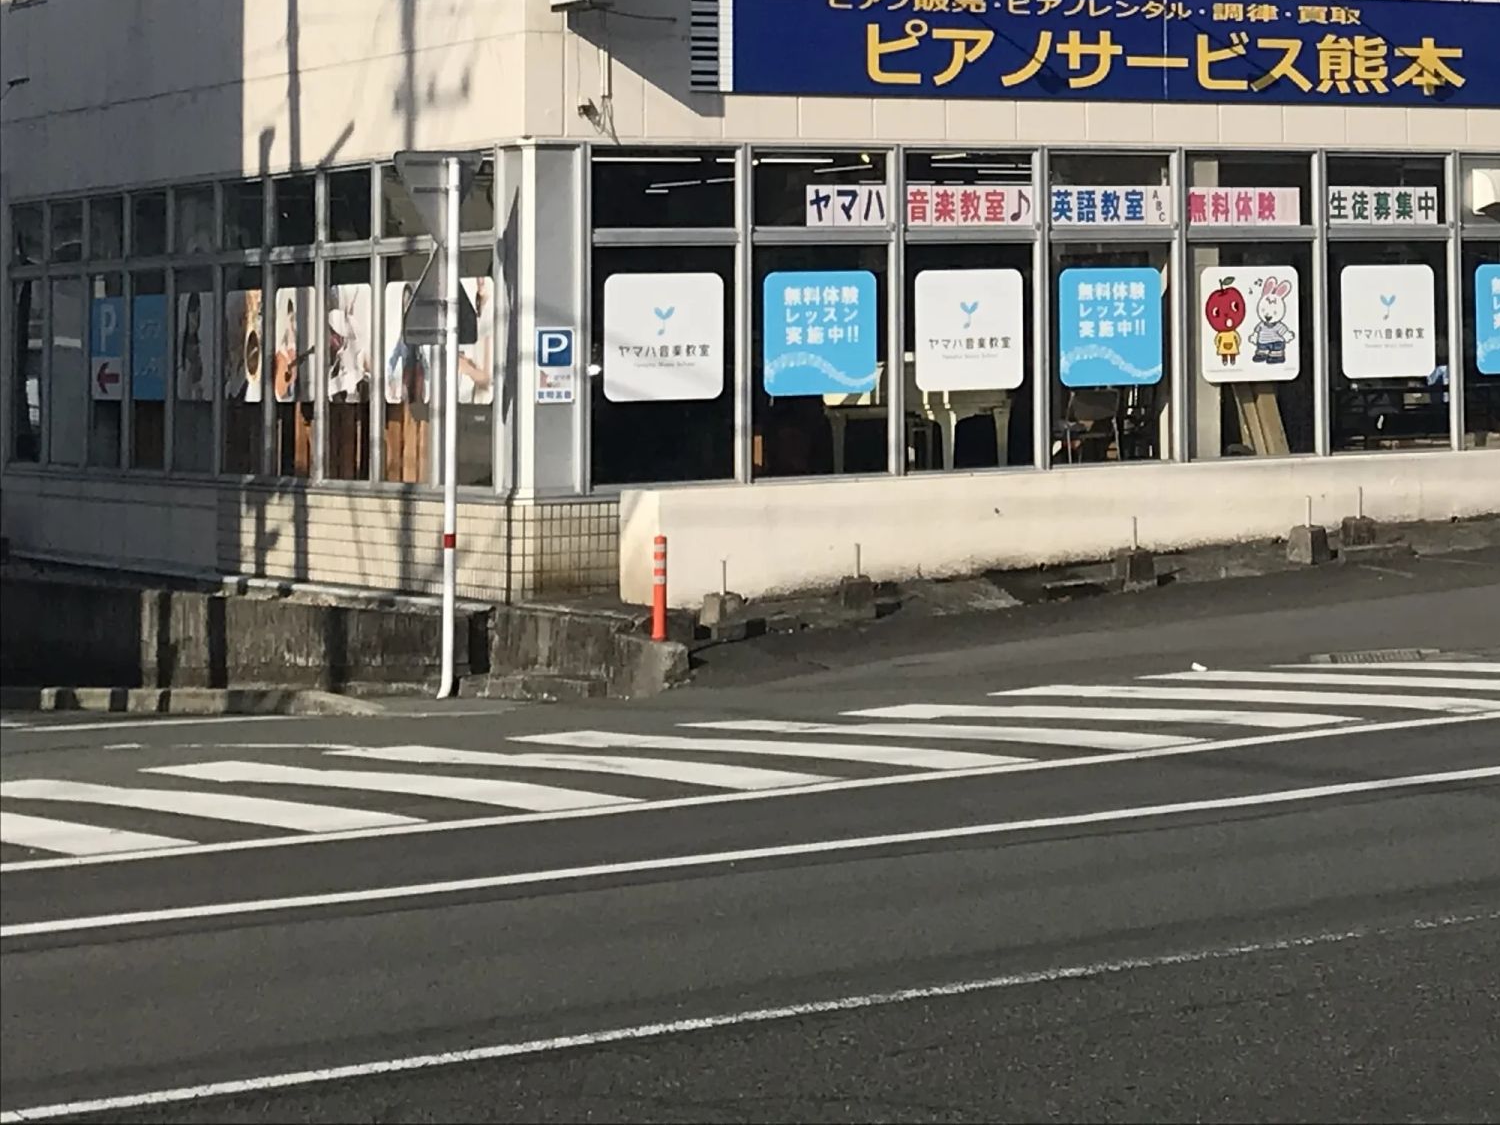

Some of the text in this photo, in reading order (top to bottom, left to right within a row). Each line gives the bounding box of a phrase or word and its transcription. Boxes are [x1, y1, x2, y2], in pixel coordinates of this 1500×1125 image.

[867, 18, 1466, 96] ピアノサービス熊本
[809, 190, 885, 223] ヤマハ
[907, 190, 1006, 223] 音楽教室
[1052, 190, 1145, 223] 英語教室
[1187, 191, 1276, 223] 無料体験
[1329, 191, 1436, 222] 生徒募集中
[786, 307, 859, 324] レッスン
[1079, 302, 1145, 319] レッスン
[542, 333, 568, 364] P
[618, 344, 710, 358] ヤマハ音楽教室
